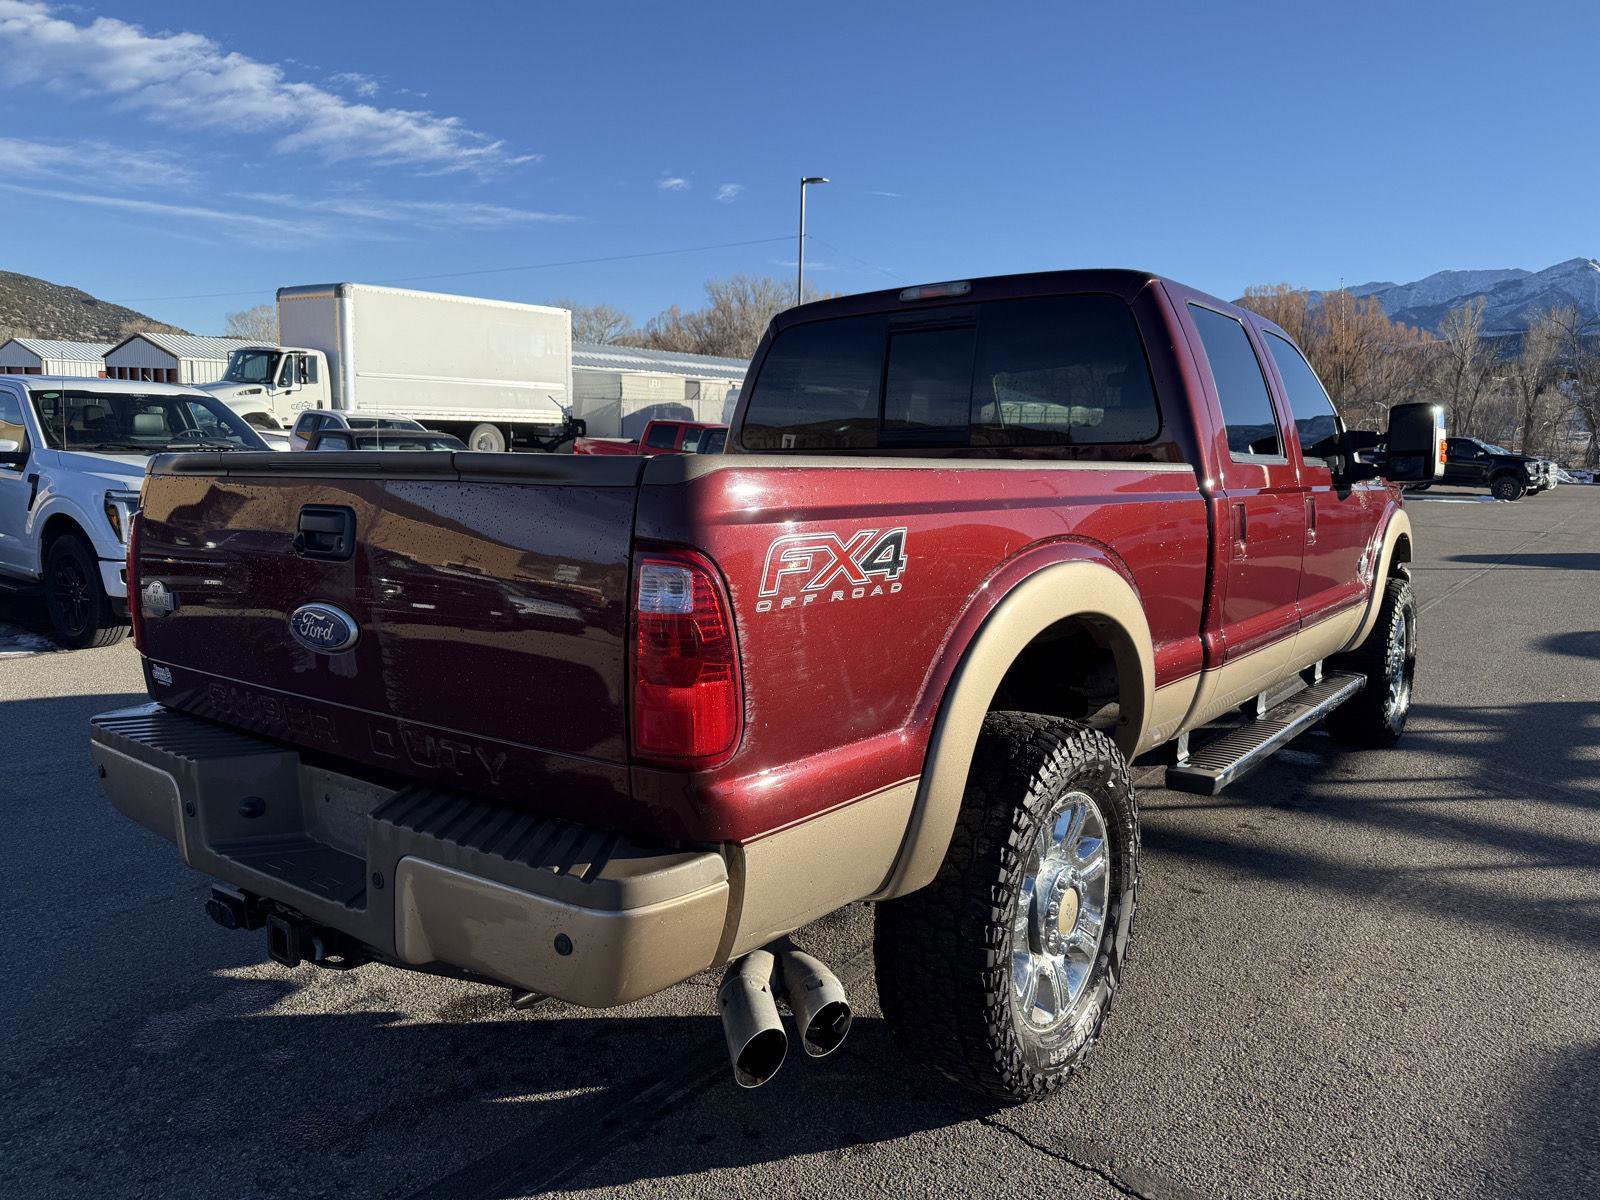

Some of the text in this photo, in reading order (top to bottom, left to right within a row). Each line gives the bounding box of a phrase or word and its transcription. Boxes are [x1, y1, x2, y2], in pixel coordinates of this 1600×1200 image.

[758, 526, 908, 598] FX4
[755, 582, 903, 613] OFF ROAD
[299, 611, 335, 641] Ford
[367, 717, 506, 786] DUTY
